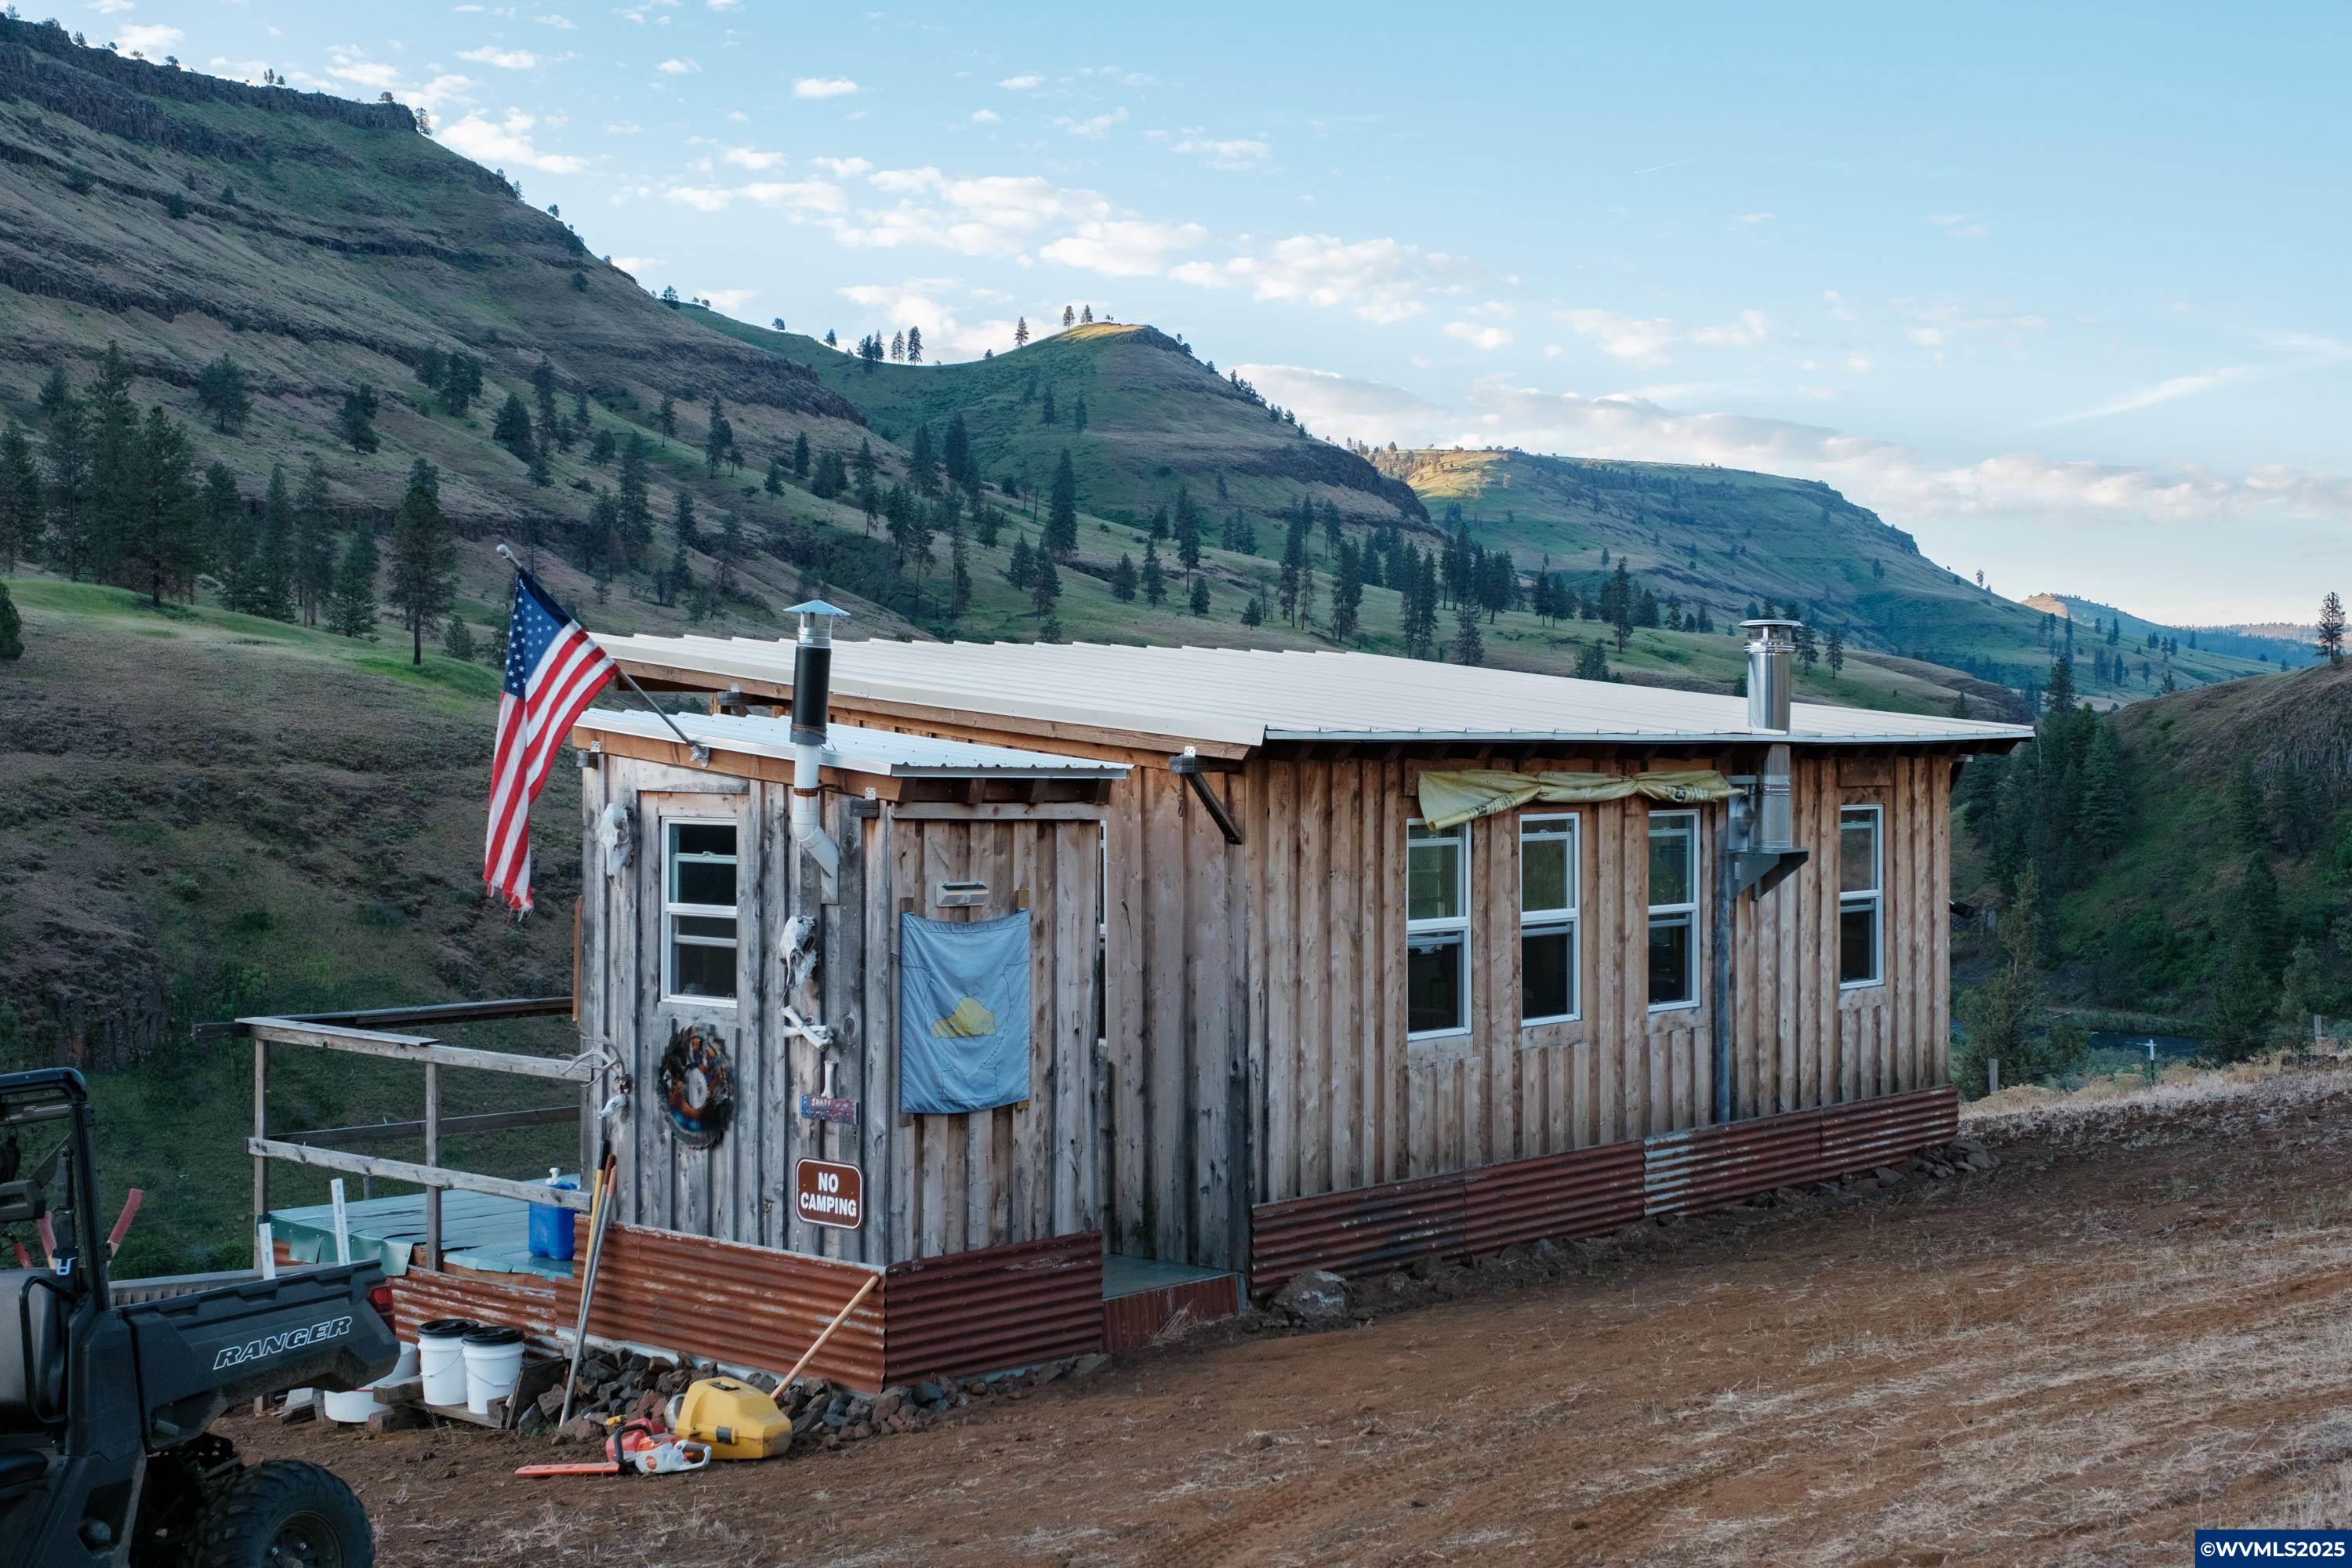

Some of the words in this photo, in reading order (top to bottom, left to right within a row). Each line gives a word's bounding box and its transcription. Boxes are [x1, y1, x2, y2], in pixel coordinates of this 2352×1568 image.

[818, 1172, 839, 1193] NO
[800, 1192, 857, 1218] CAMPING
[213, 1316, 352, 1370] RANGER
